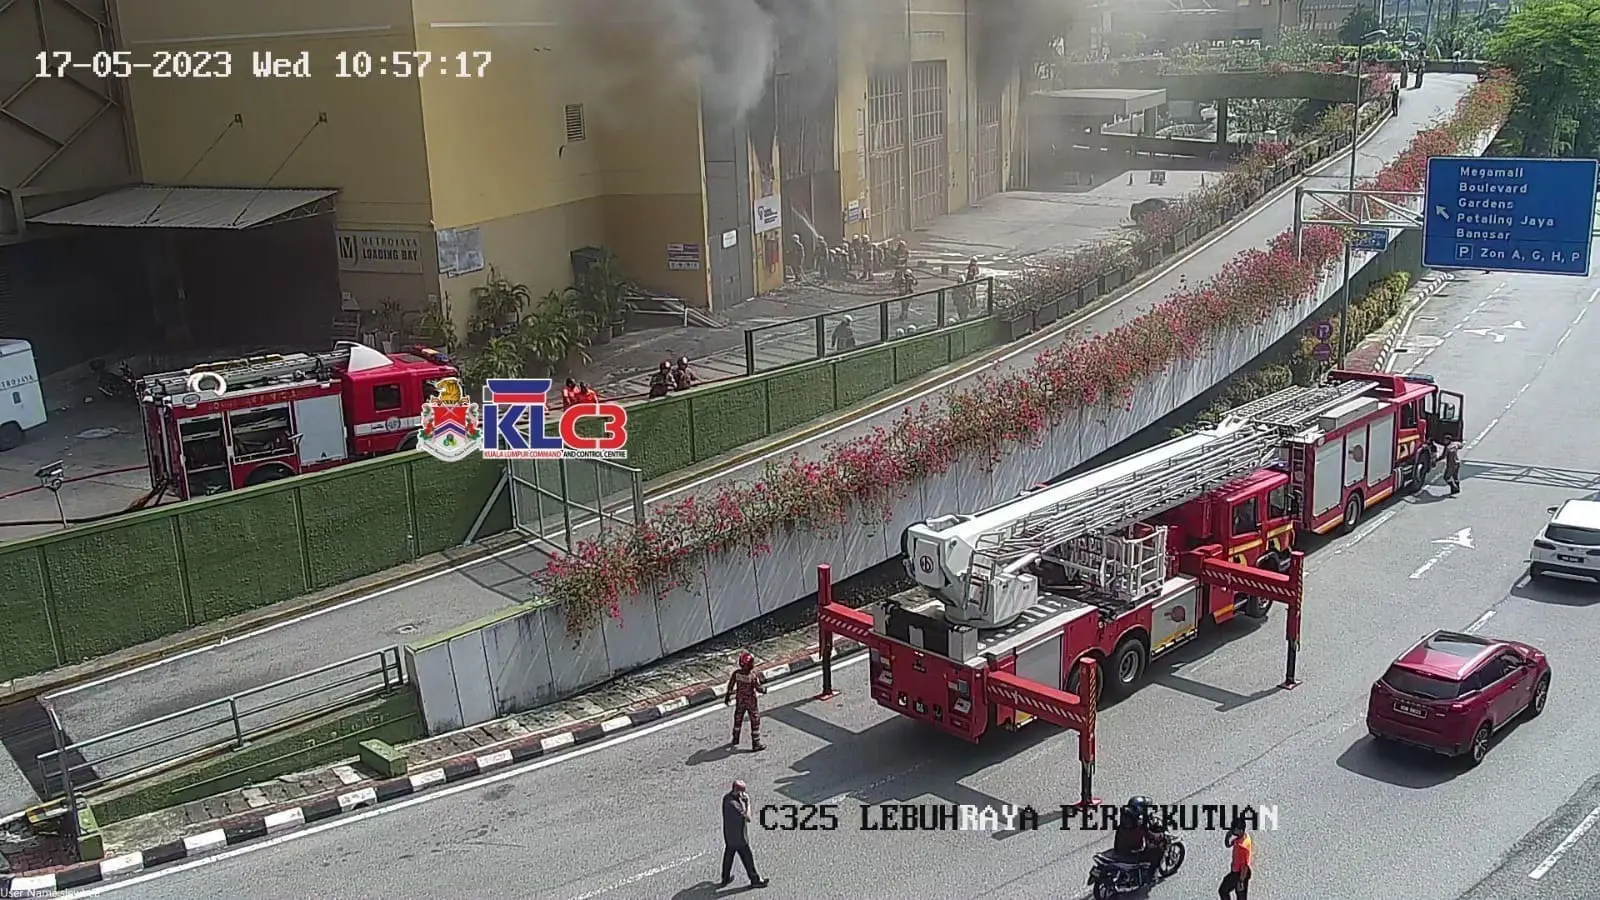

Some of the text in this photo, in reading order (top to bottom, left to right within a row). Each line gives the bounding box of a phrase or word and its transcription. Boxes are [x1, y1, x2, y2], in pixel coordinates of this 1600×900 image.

[1460, 167, 1523, 178] Megamall
[1459, 182, 1528, 193] Boulevard
[1458, 198, 1513, 209] Gardens
[1457, 213, 1554, 228] Petaling Jaya
[1456, 228, 1510, 240] Bangsar
[363, 248, 418, 261] LOADING BAY
[1460, 247, 1580, 262] P Zon A, G, H, P
